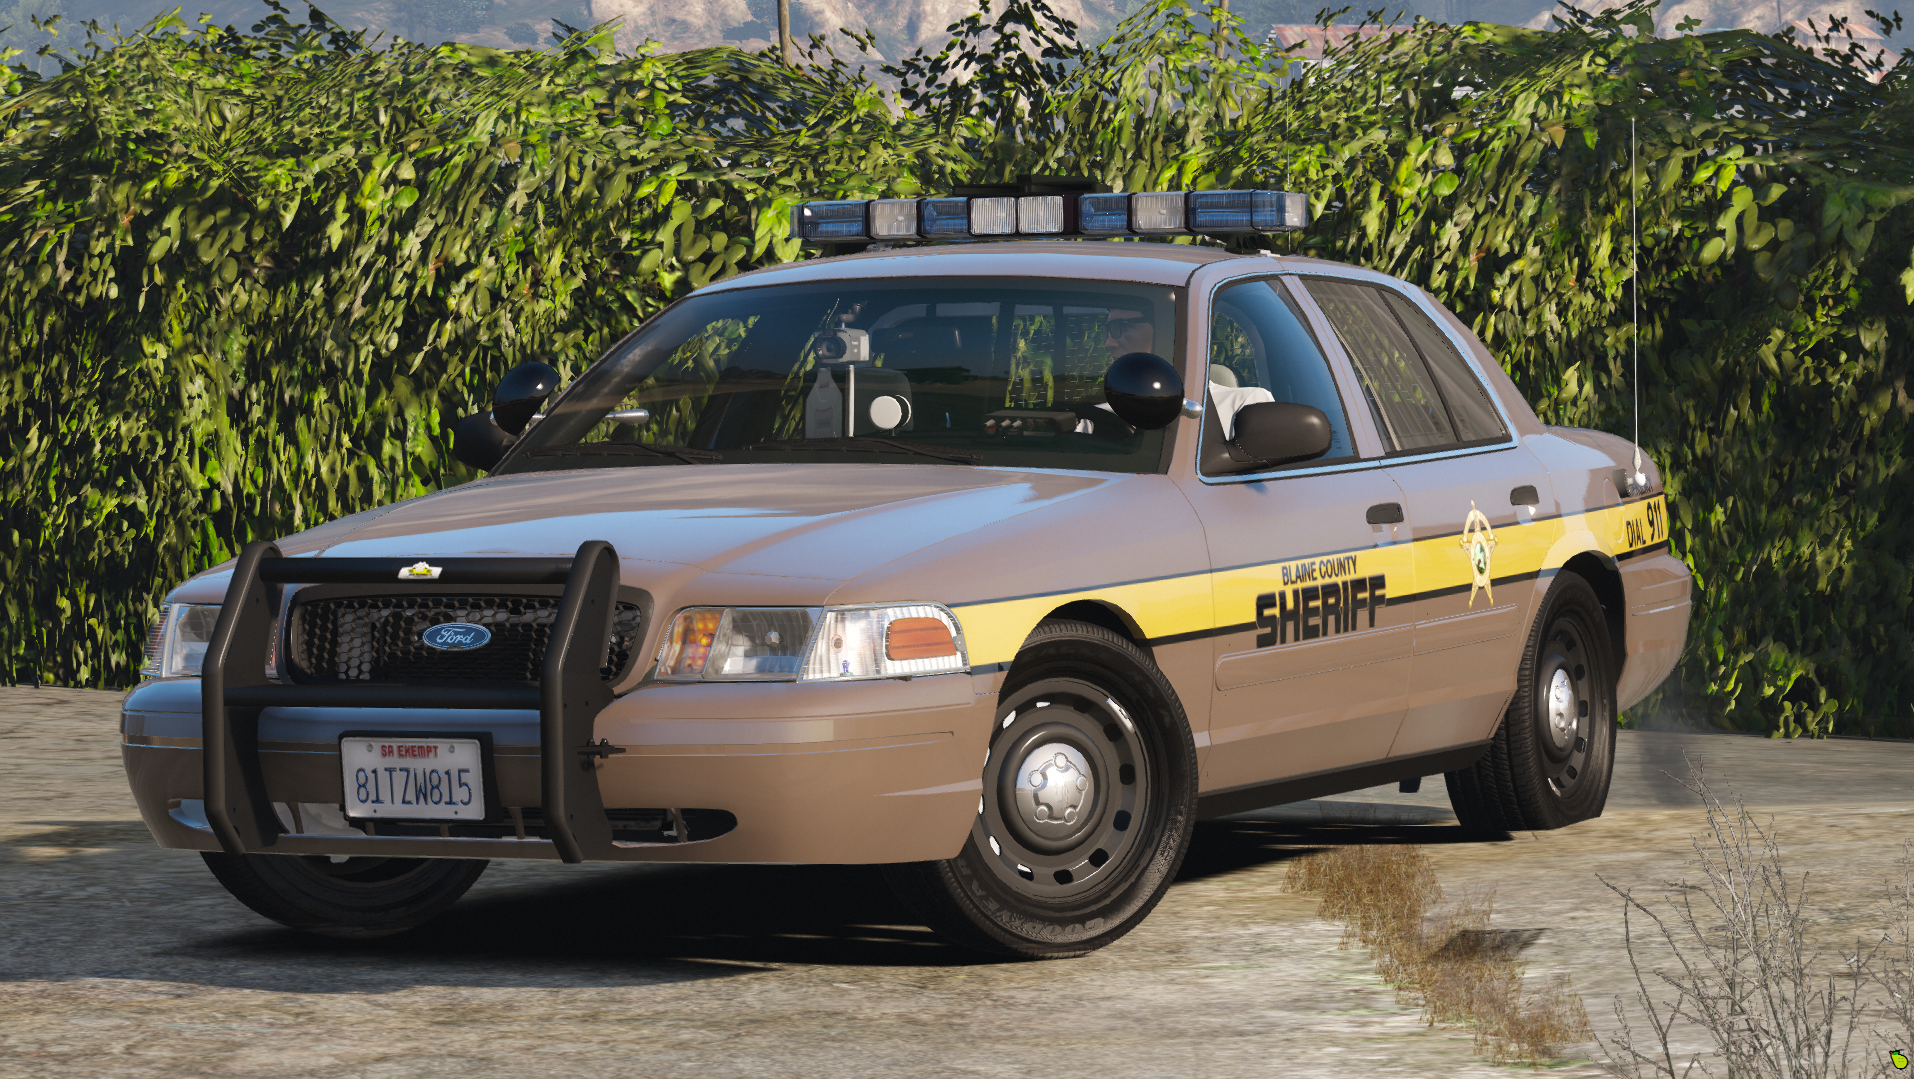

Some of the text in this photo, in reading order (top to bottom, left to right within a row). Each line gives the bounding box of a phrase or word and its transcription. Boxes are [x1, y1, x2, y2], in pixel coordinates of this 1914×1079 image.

[1626, 499, 1663, 548] DIAL 911
[1282, 555, 1357, 586] BLAINE COUNTY
[1256, 573, 1387, 649] SHERIFF
[436, 627, 475, 644] Ford
[381, 745, 439, 758] SA EXEMPT
[355, 767, 472, 806] 81TZW815
